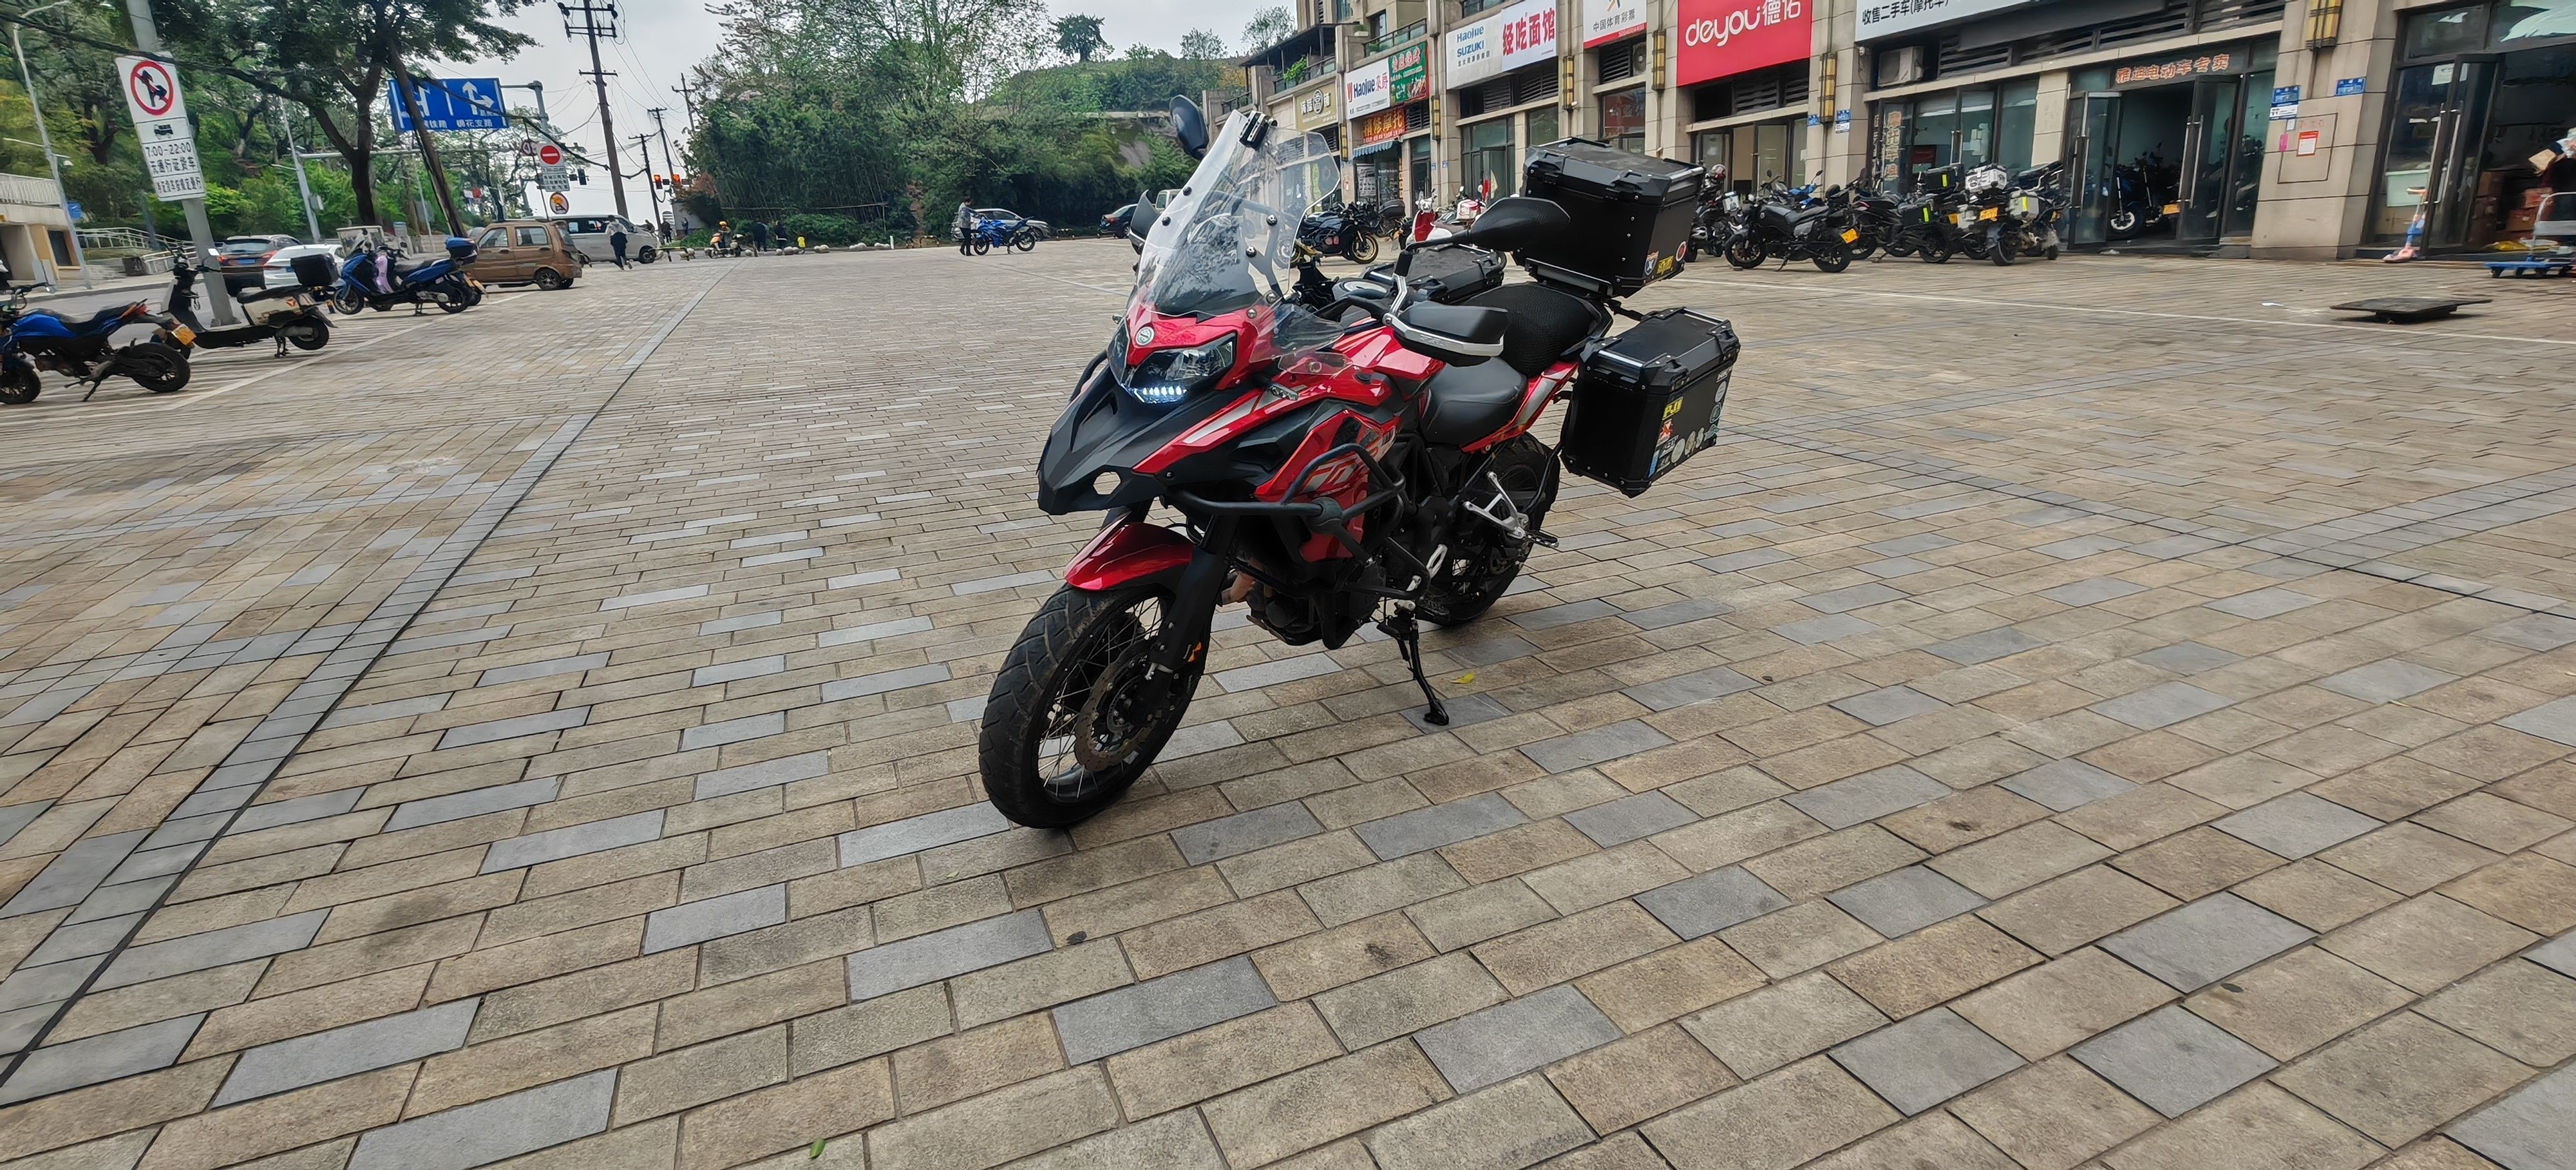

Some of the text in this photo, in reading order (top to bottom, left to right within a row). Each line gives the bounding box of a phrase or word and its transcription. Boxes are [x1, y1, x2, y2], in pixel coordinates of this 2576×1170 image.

[1593, 8, 1636, 32] 中国体育彩票
[1457, 26, 1484, 43] Haojue
[1457, 40, 1484, 57] SUZUKI
[1353, 78, 1376, 99] Haojue
